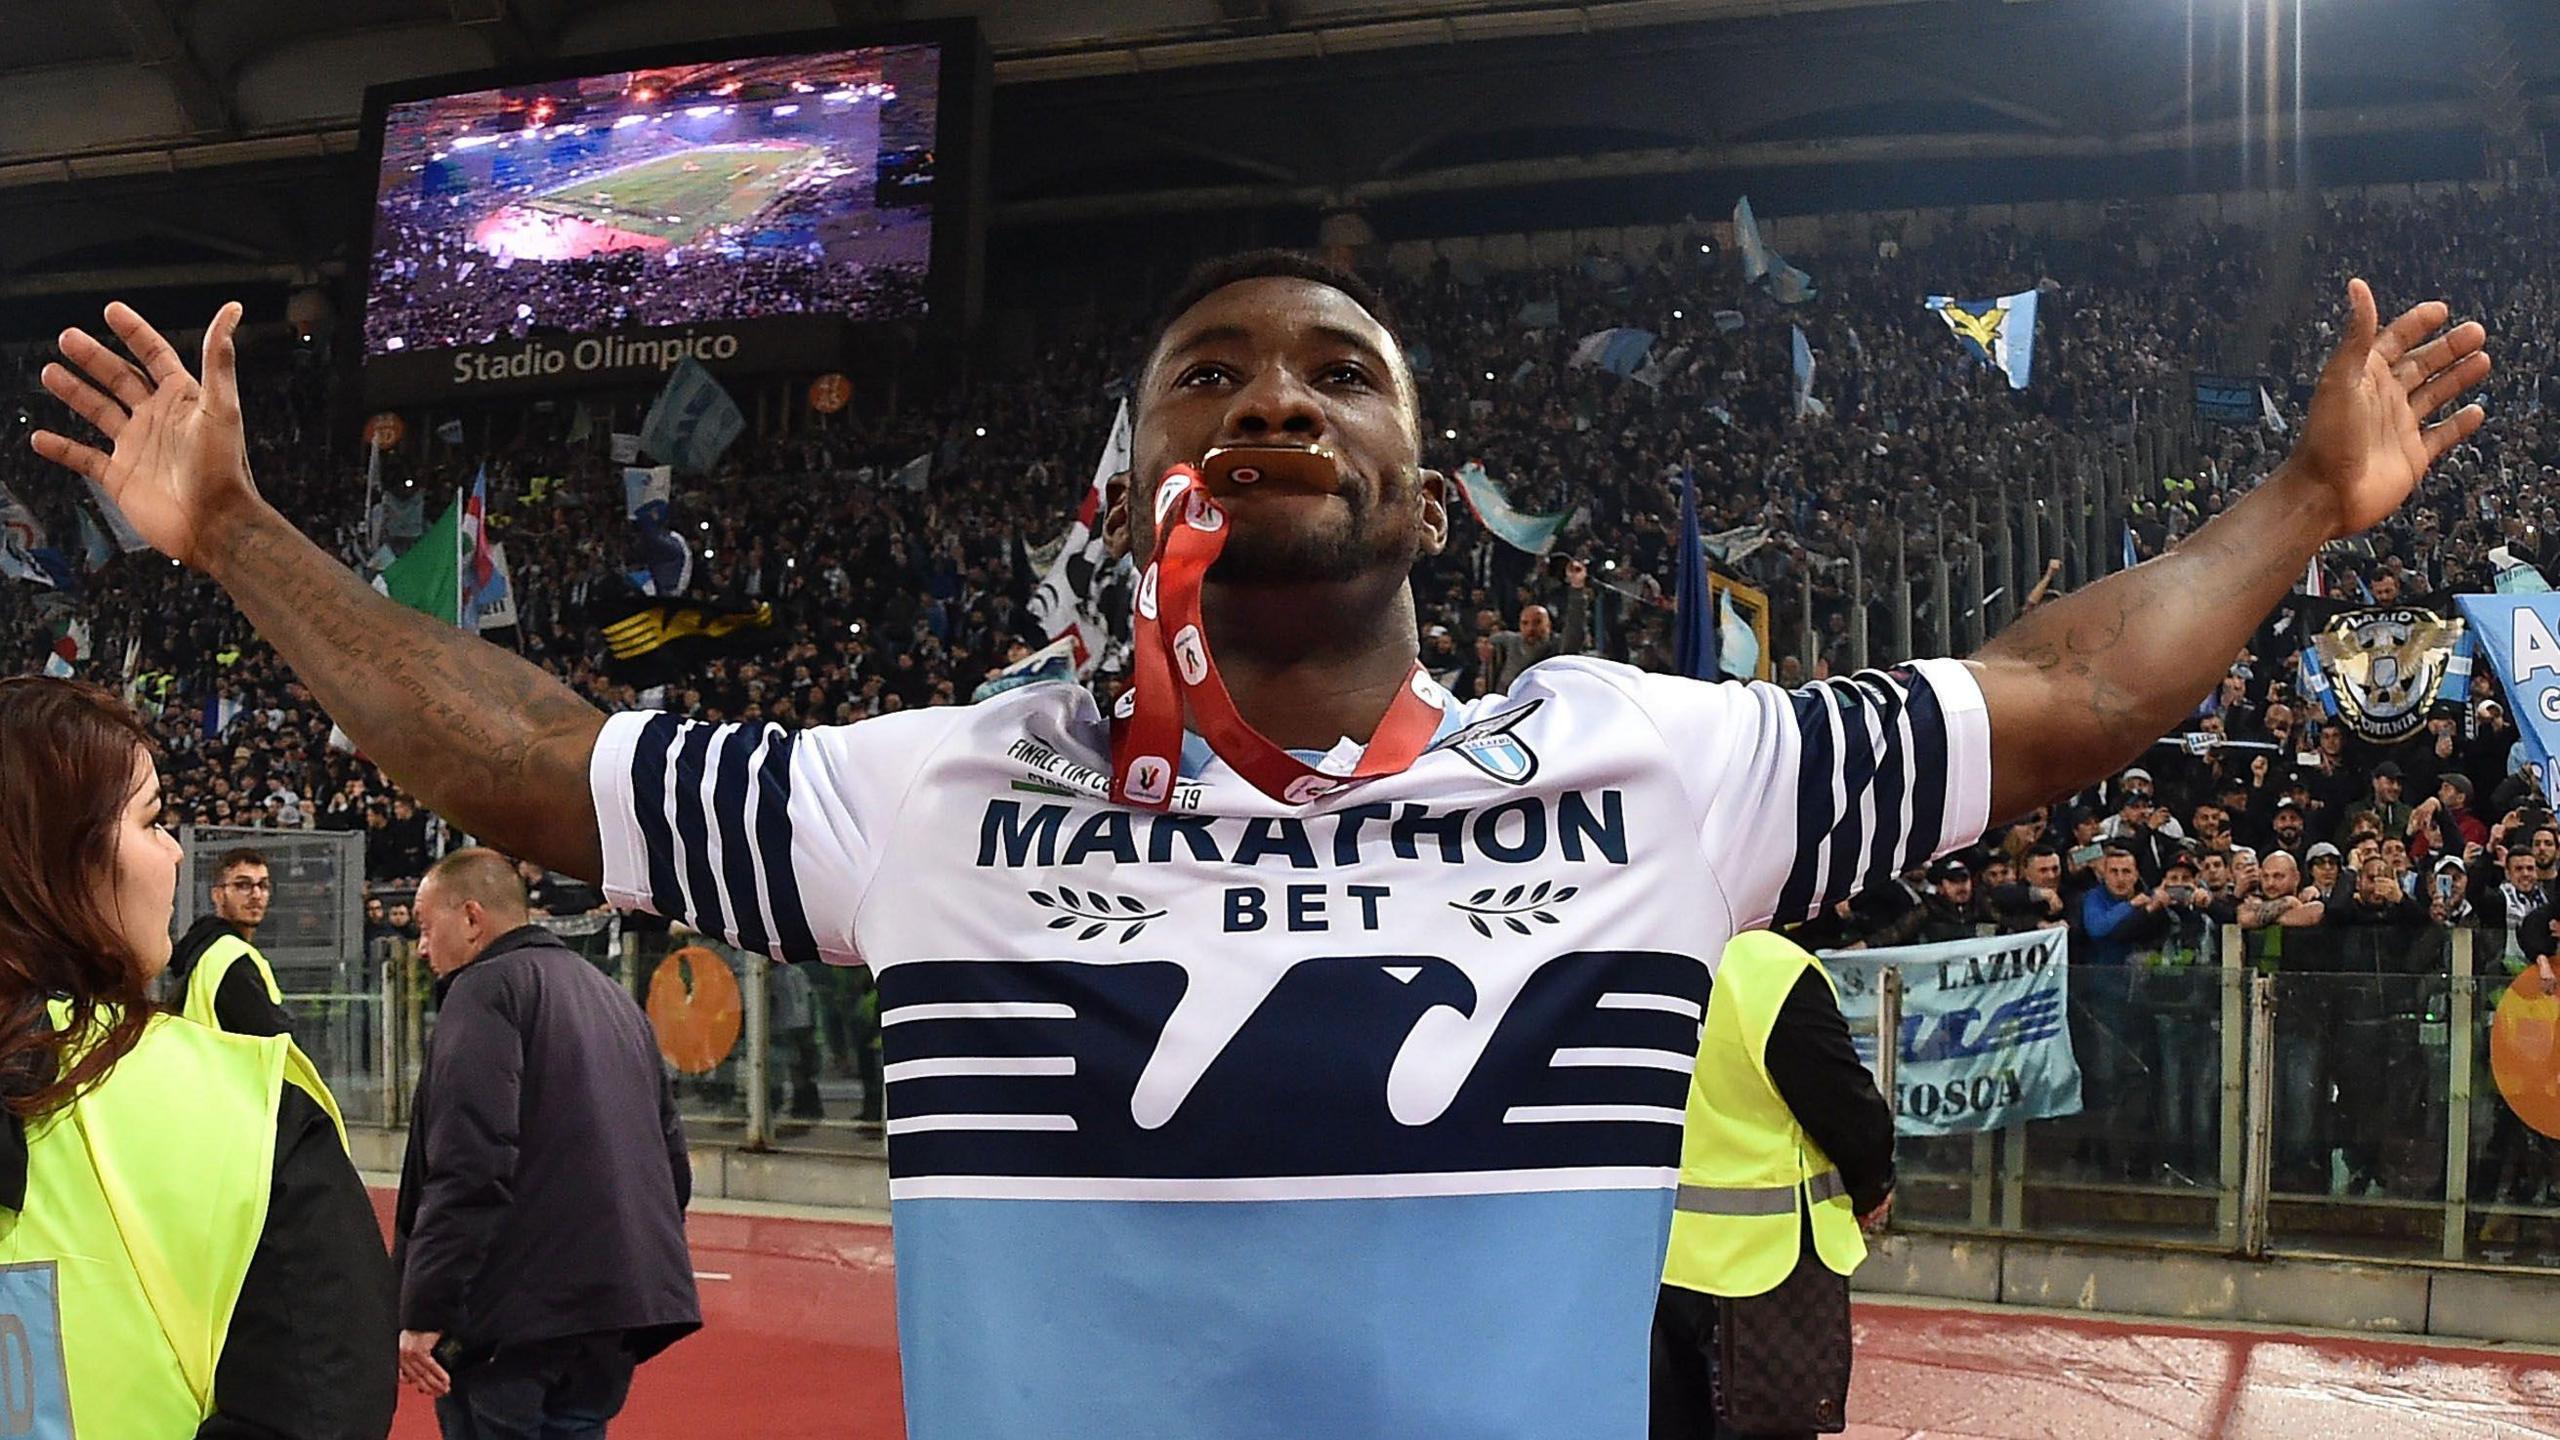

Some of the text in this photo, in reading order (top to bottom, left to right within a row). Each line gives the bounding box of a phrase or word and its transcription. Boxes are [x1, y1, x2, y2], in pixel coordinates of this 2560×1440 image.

[454, 329, 738, 383] Stadio Olimpico
[1007, 738, 1064, 773] FINALE
[1061, 762, 1095, 786] TIM
[1172, 788, 1202, 810] -19
[976, 788, 1630, 869] MARATHON
[1222, 883, 1391, 933] BET
[1937, 942, 2049, 992] LAZIO
